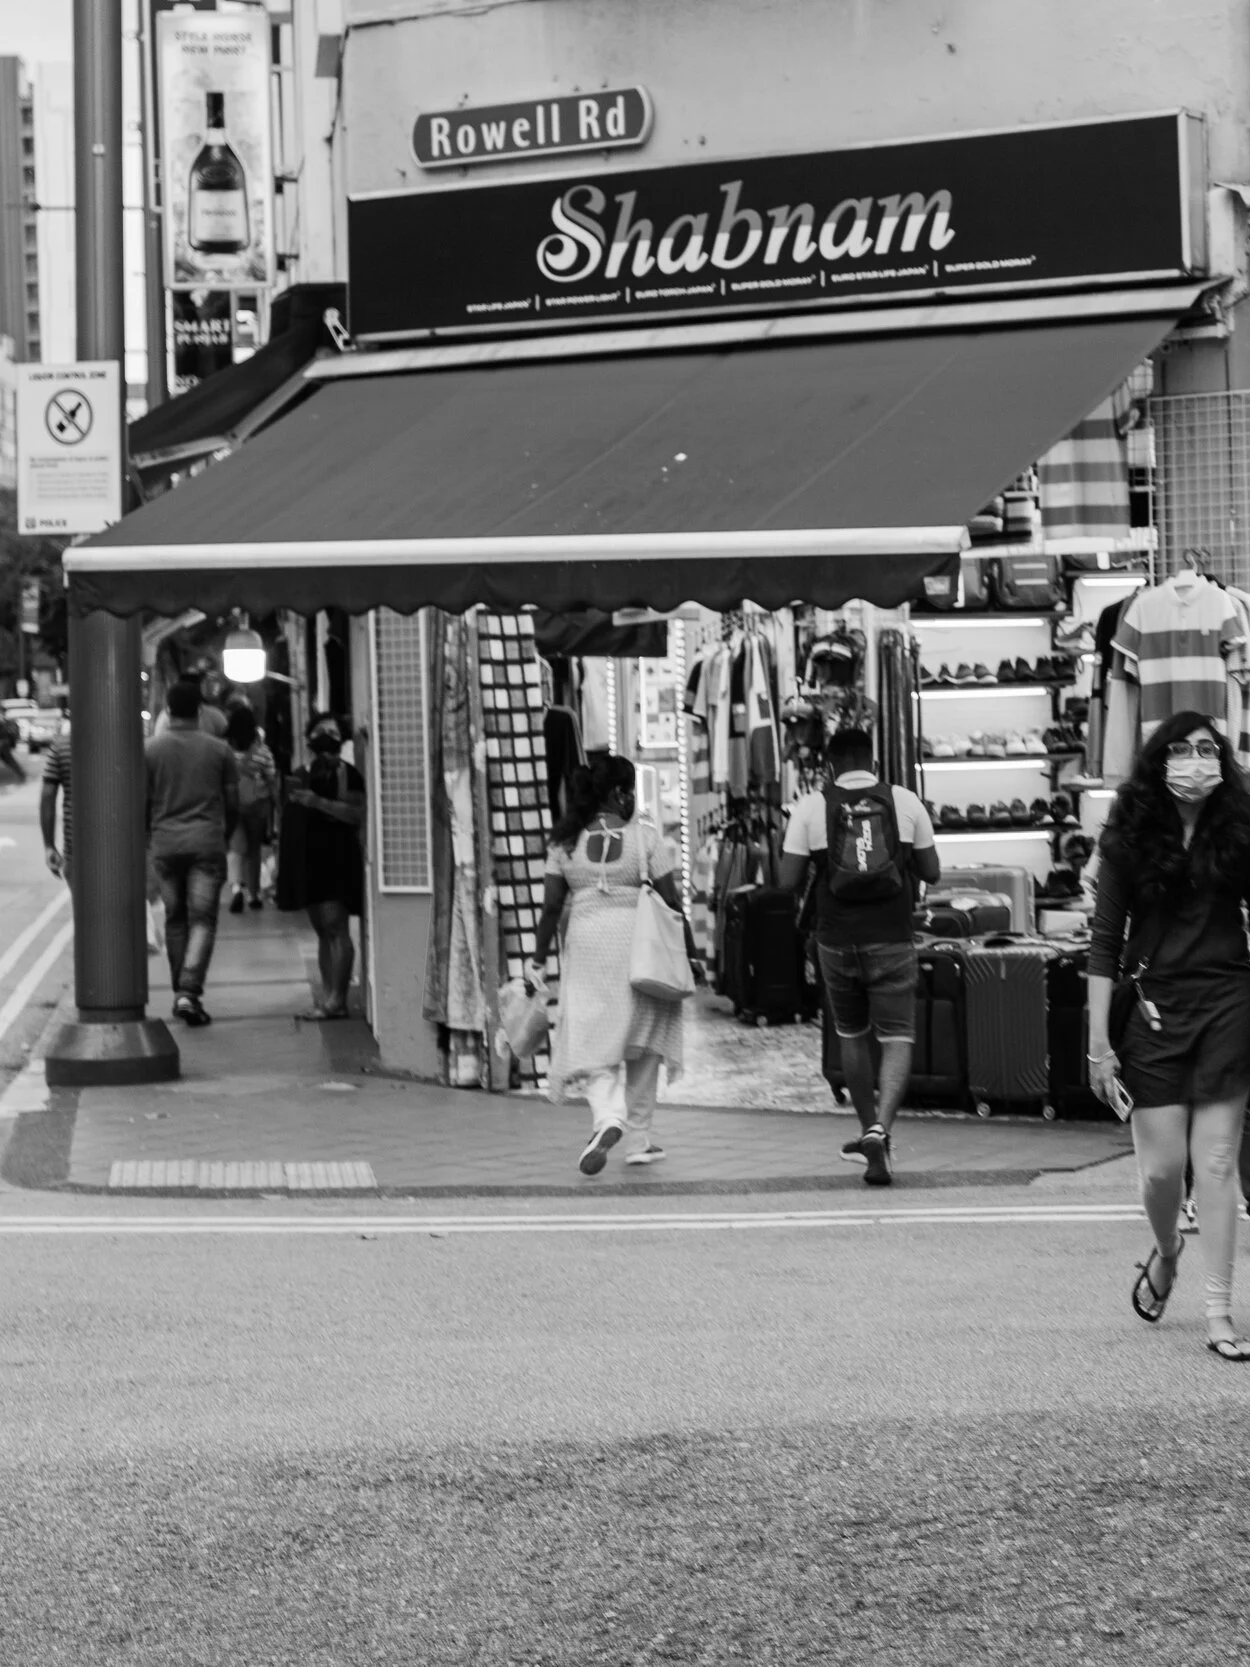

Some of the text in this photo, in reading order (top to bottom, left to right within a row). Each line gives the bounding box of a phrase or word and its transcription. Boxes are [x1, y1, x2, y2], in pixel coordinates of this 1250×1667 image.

[430, 95, 626, 157] Rowell Rd
[536, 180, 956, 283] Shabnam
